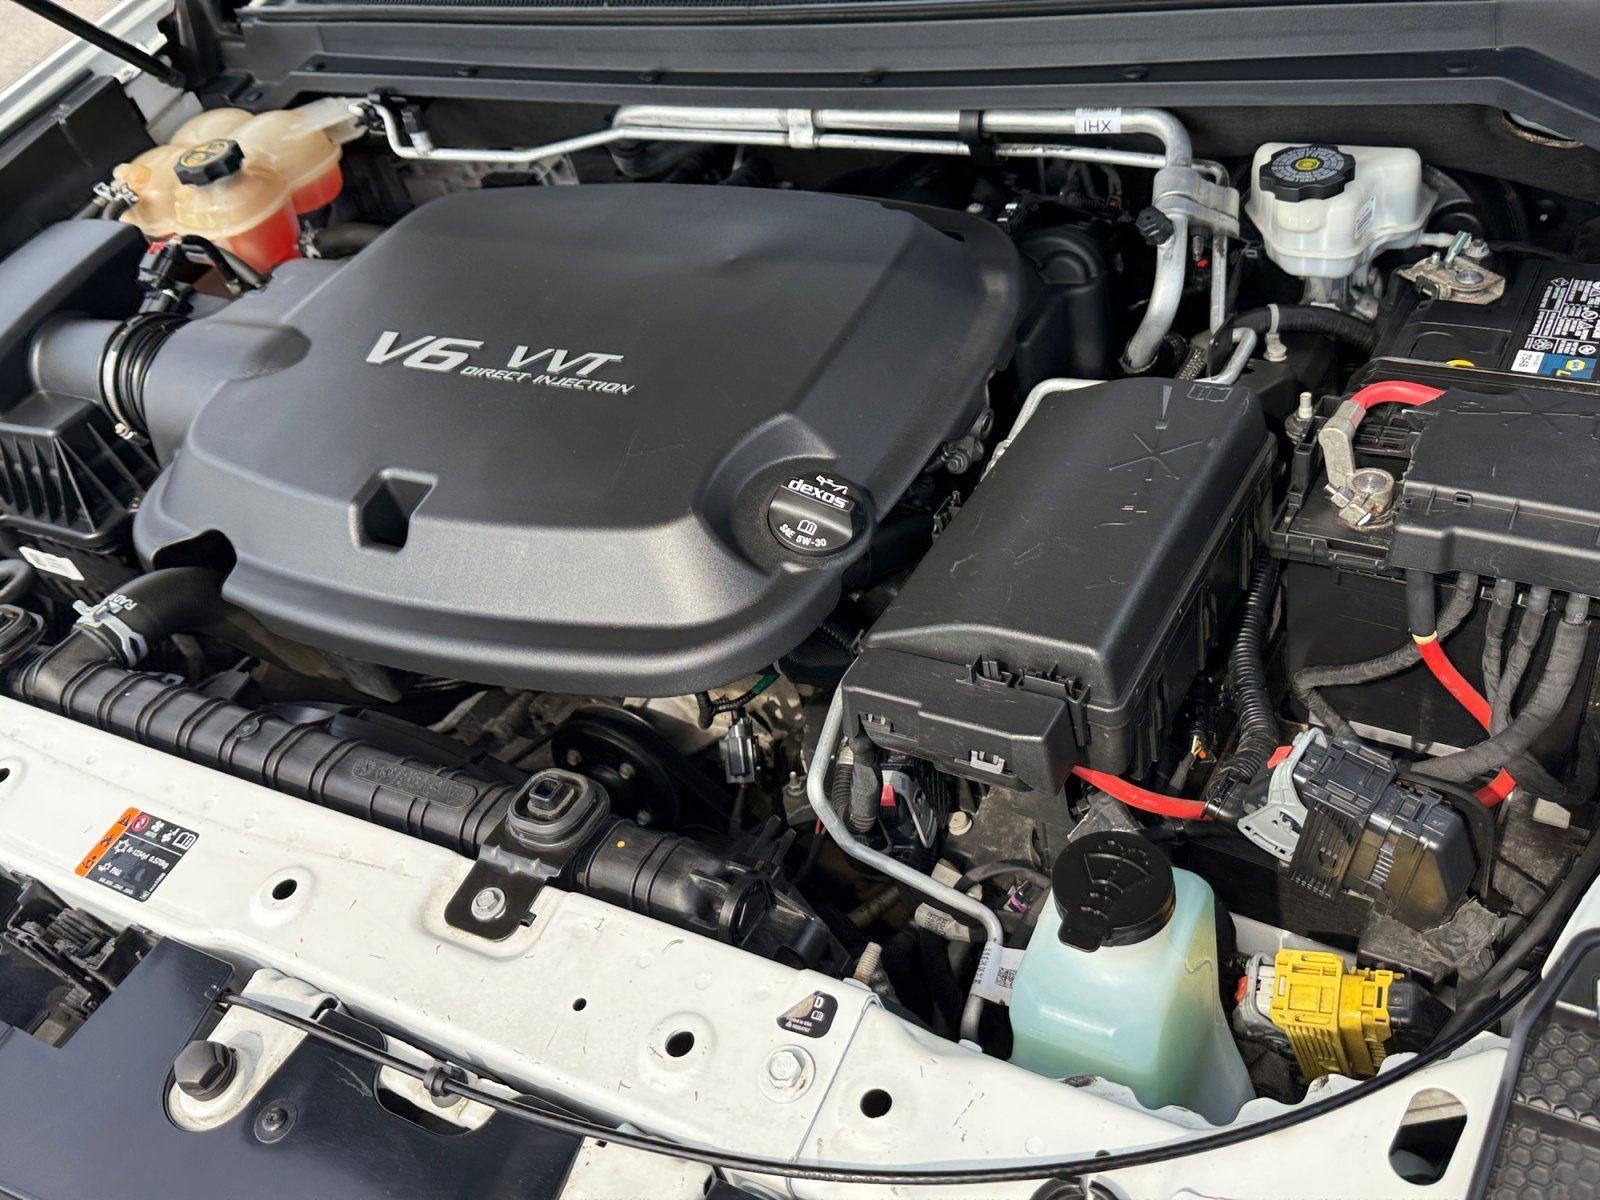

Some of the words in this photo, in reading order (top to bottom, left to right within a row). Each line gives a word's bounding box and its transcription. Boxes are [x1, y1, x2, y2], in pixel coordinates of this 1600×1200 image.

[1083, 119, 1112, 132] IHX
[365, 330, 485, 373] V6
[506, 344, 625, 376] VVT
[459, 366, 533, 383] DIRECT
[532, 374, 635, 395] INJECTION
[787, 478, 850, 509] dexos
[780, 524, 795, 538] SAE
[796, 535, 826, 546] 5W-30
